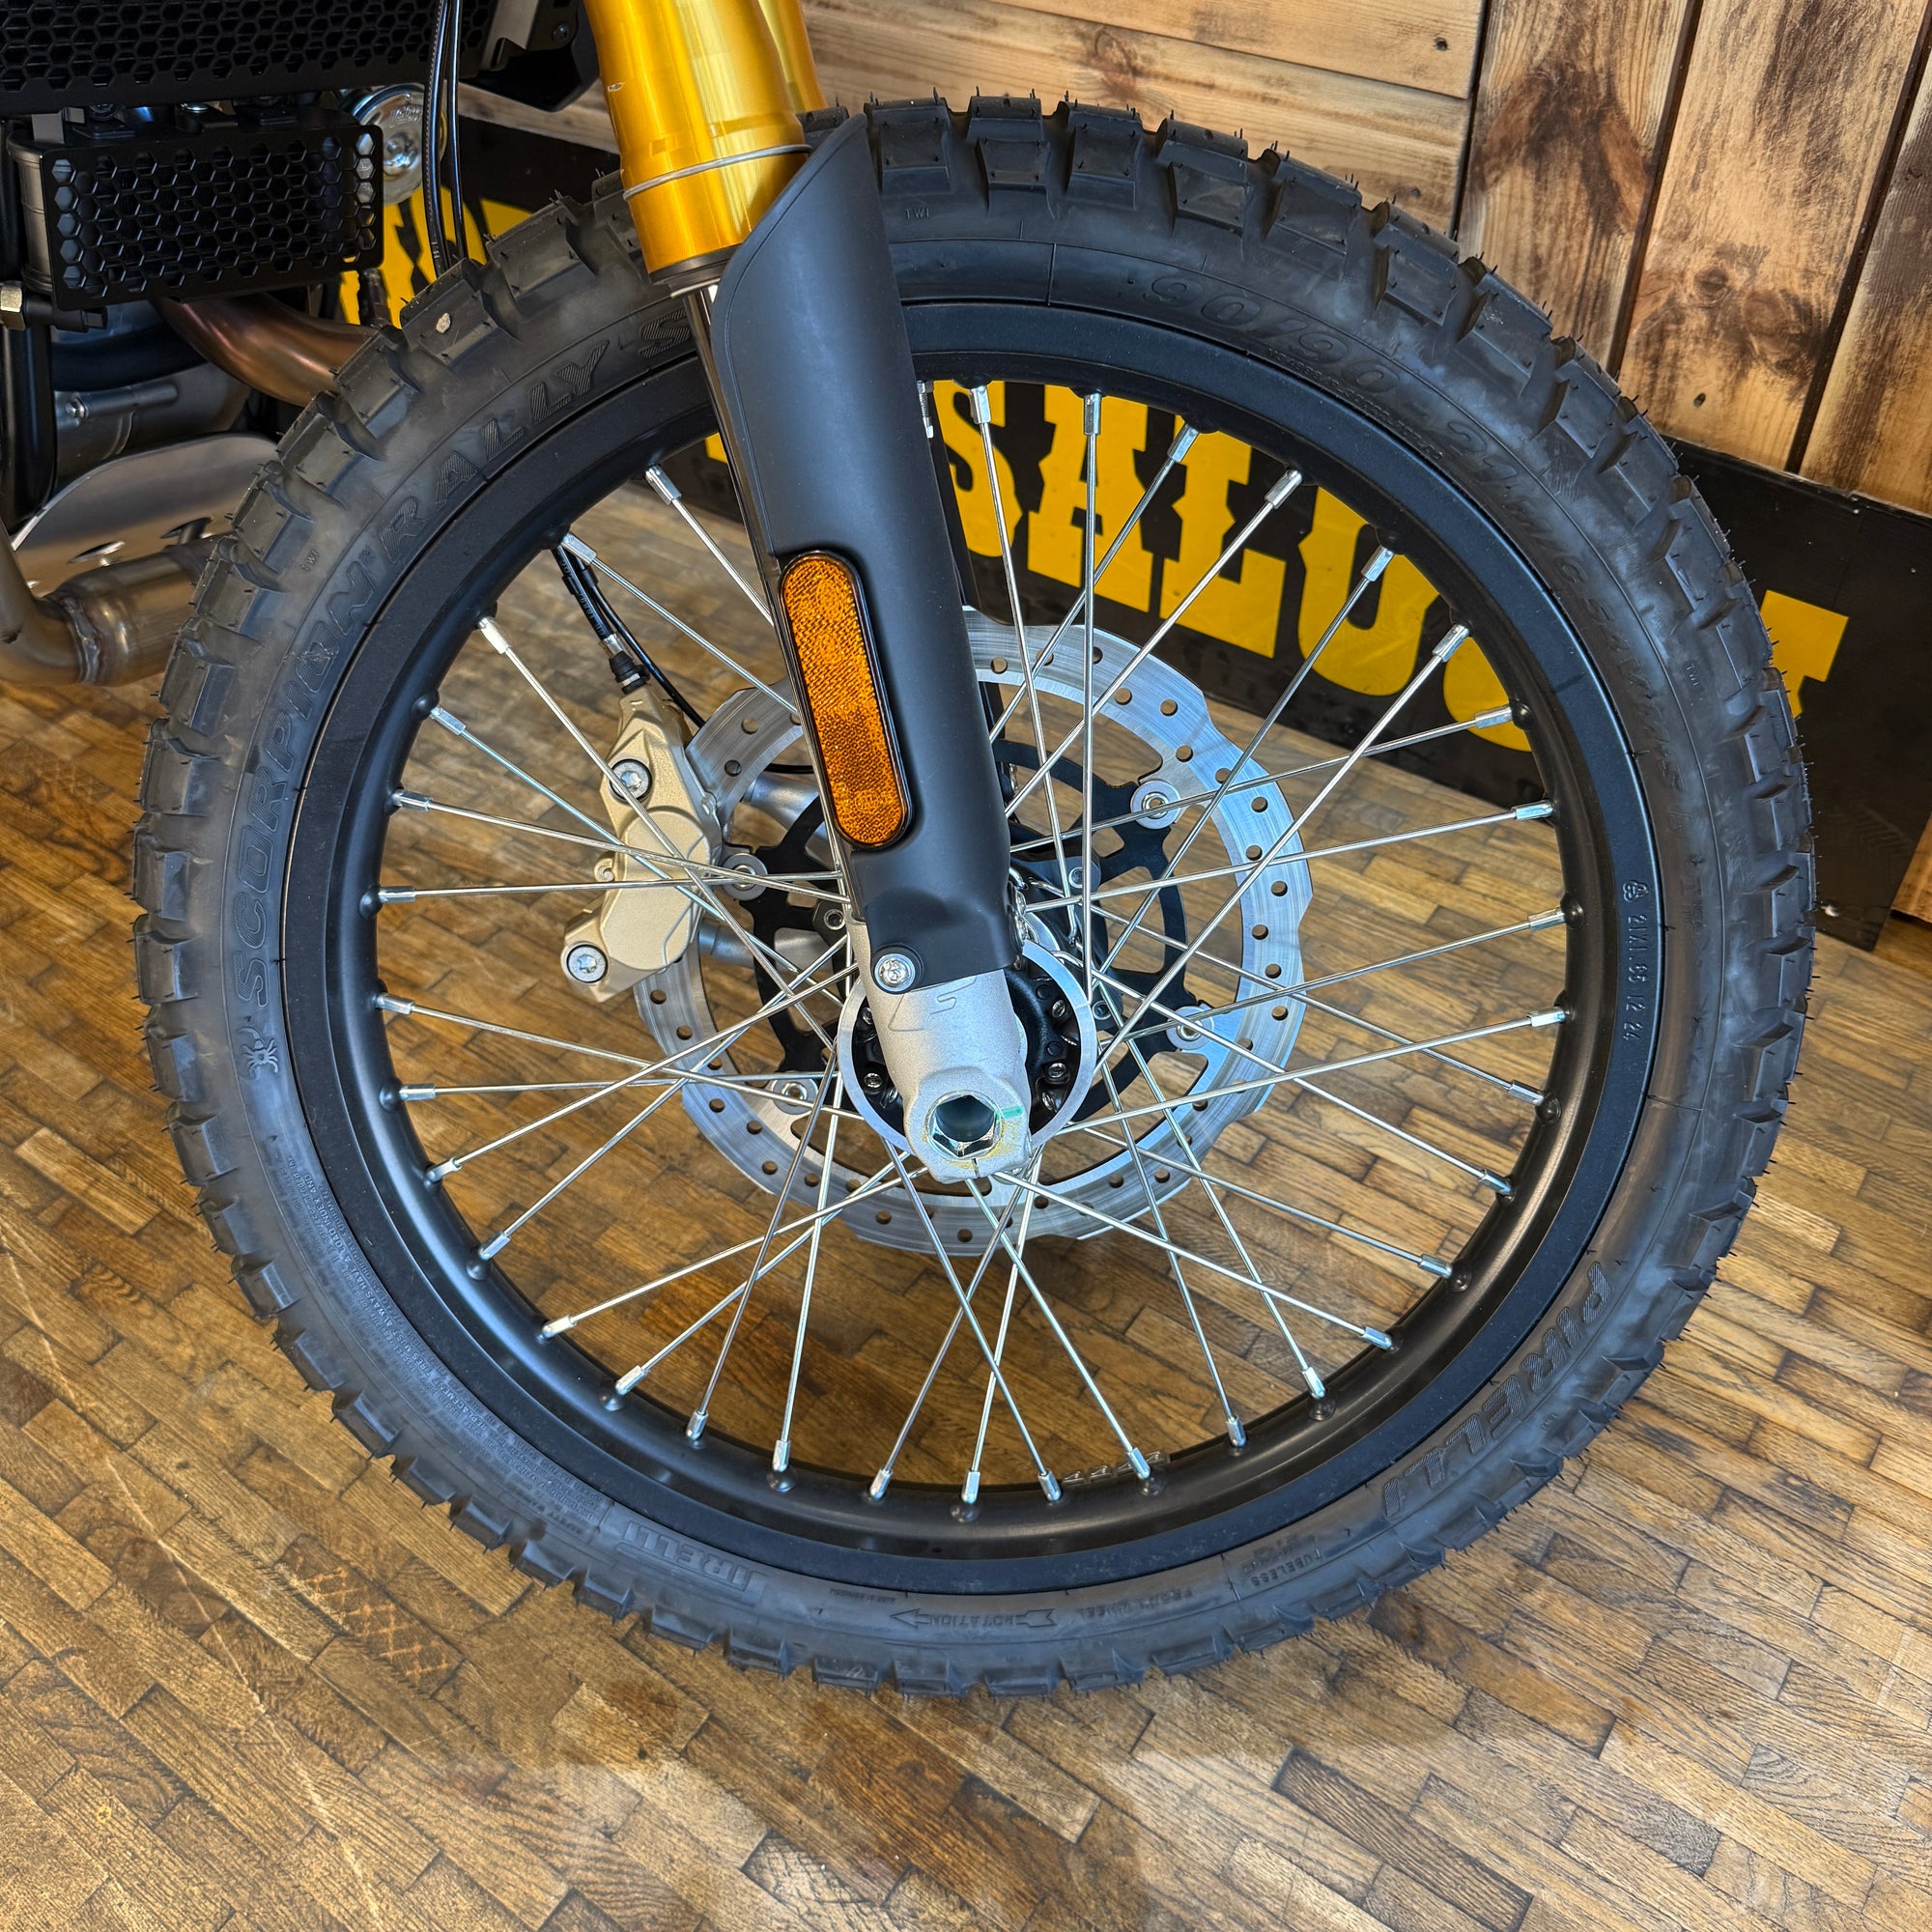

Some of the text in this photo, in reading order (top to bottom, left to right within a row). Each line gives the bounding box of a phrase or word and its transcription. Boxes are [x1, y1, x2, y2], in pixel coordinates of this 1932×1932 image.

[903, 207, 930, 220] TWI
[368, 339, 625, 566] RALLY
[298, 546, 322, 574] TWI
[233, 556, 384, 1011] SCORPION
[1622, 992, 1647, 1014] 12
[301, 1172, 318, 1194] AND
[312, 1196, 333, 1227] INDEX
[327, 1226, 348, 1254] LOAD
[345, 1239, 374, 1281] ORIGINAL
[348, 1264, 369, 1291] HAVE
[363, 1289, 394, 1328] ALWAYS
[390, 1327, 413, 1353] MUST
[409, 1350, 434, 1378] TIRES
[430, 1375, 489, 1432] REPLACEMENT
[1369, 1259, 1623, 1520] PIRELLI
[1248, 1547, 1323, 1588] TUBELESS
